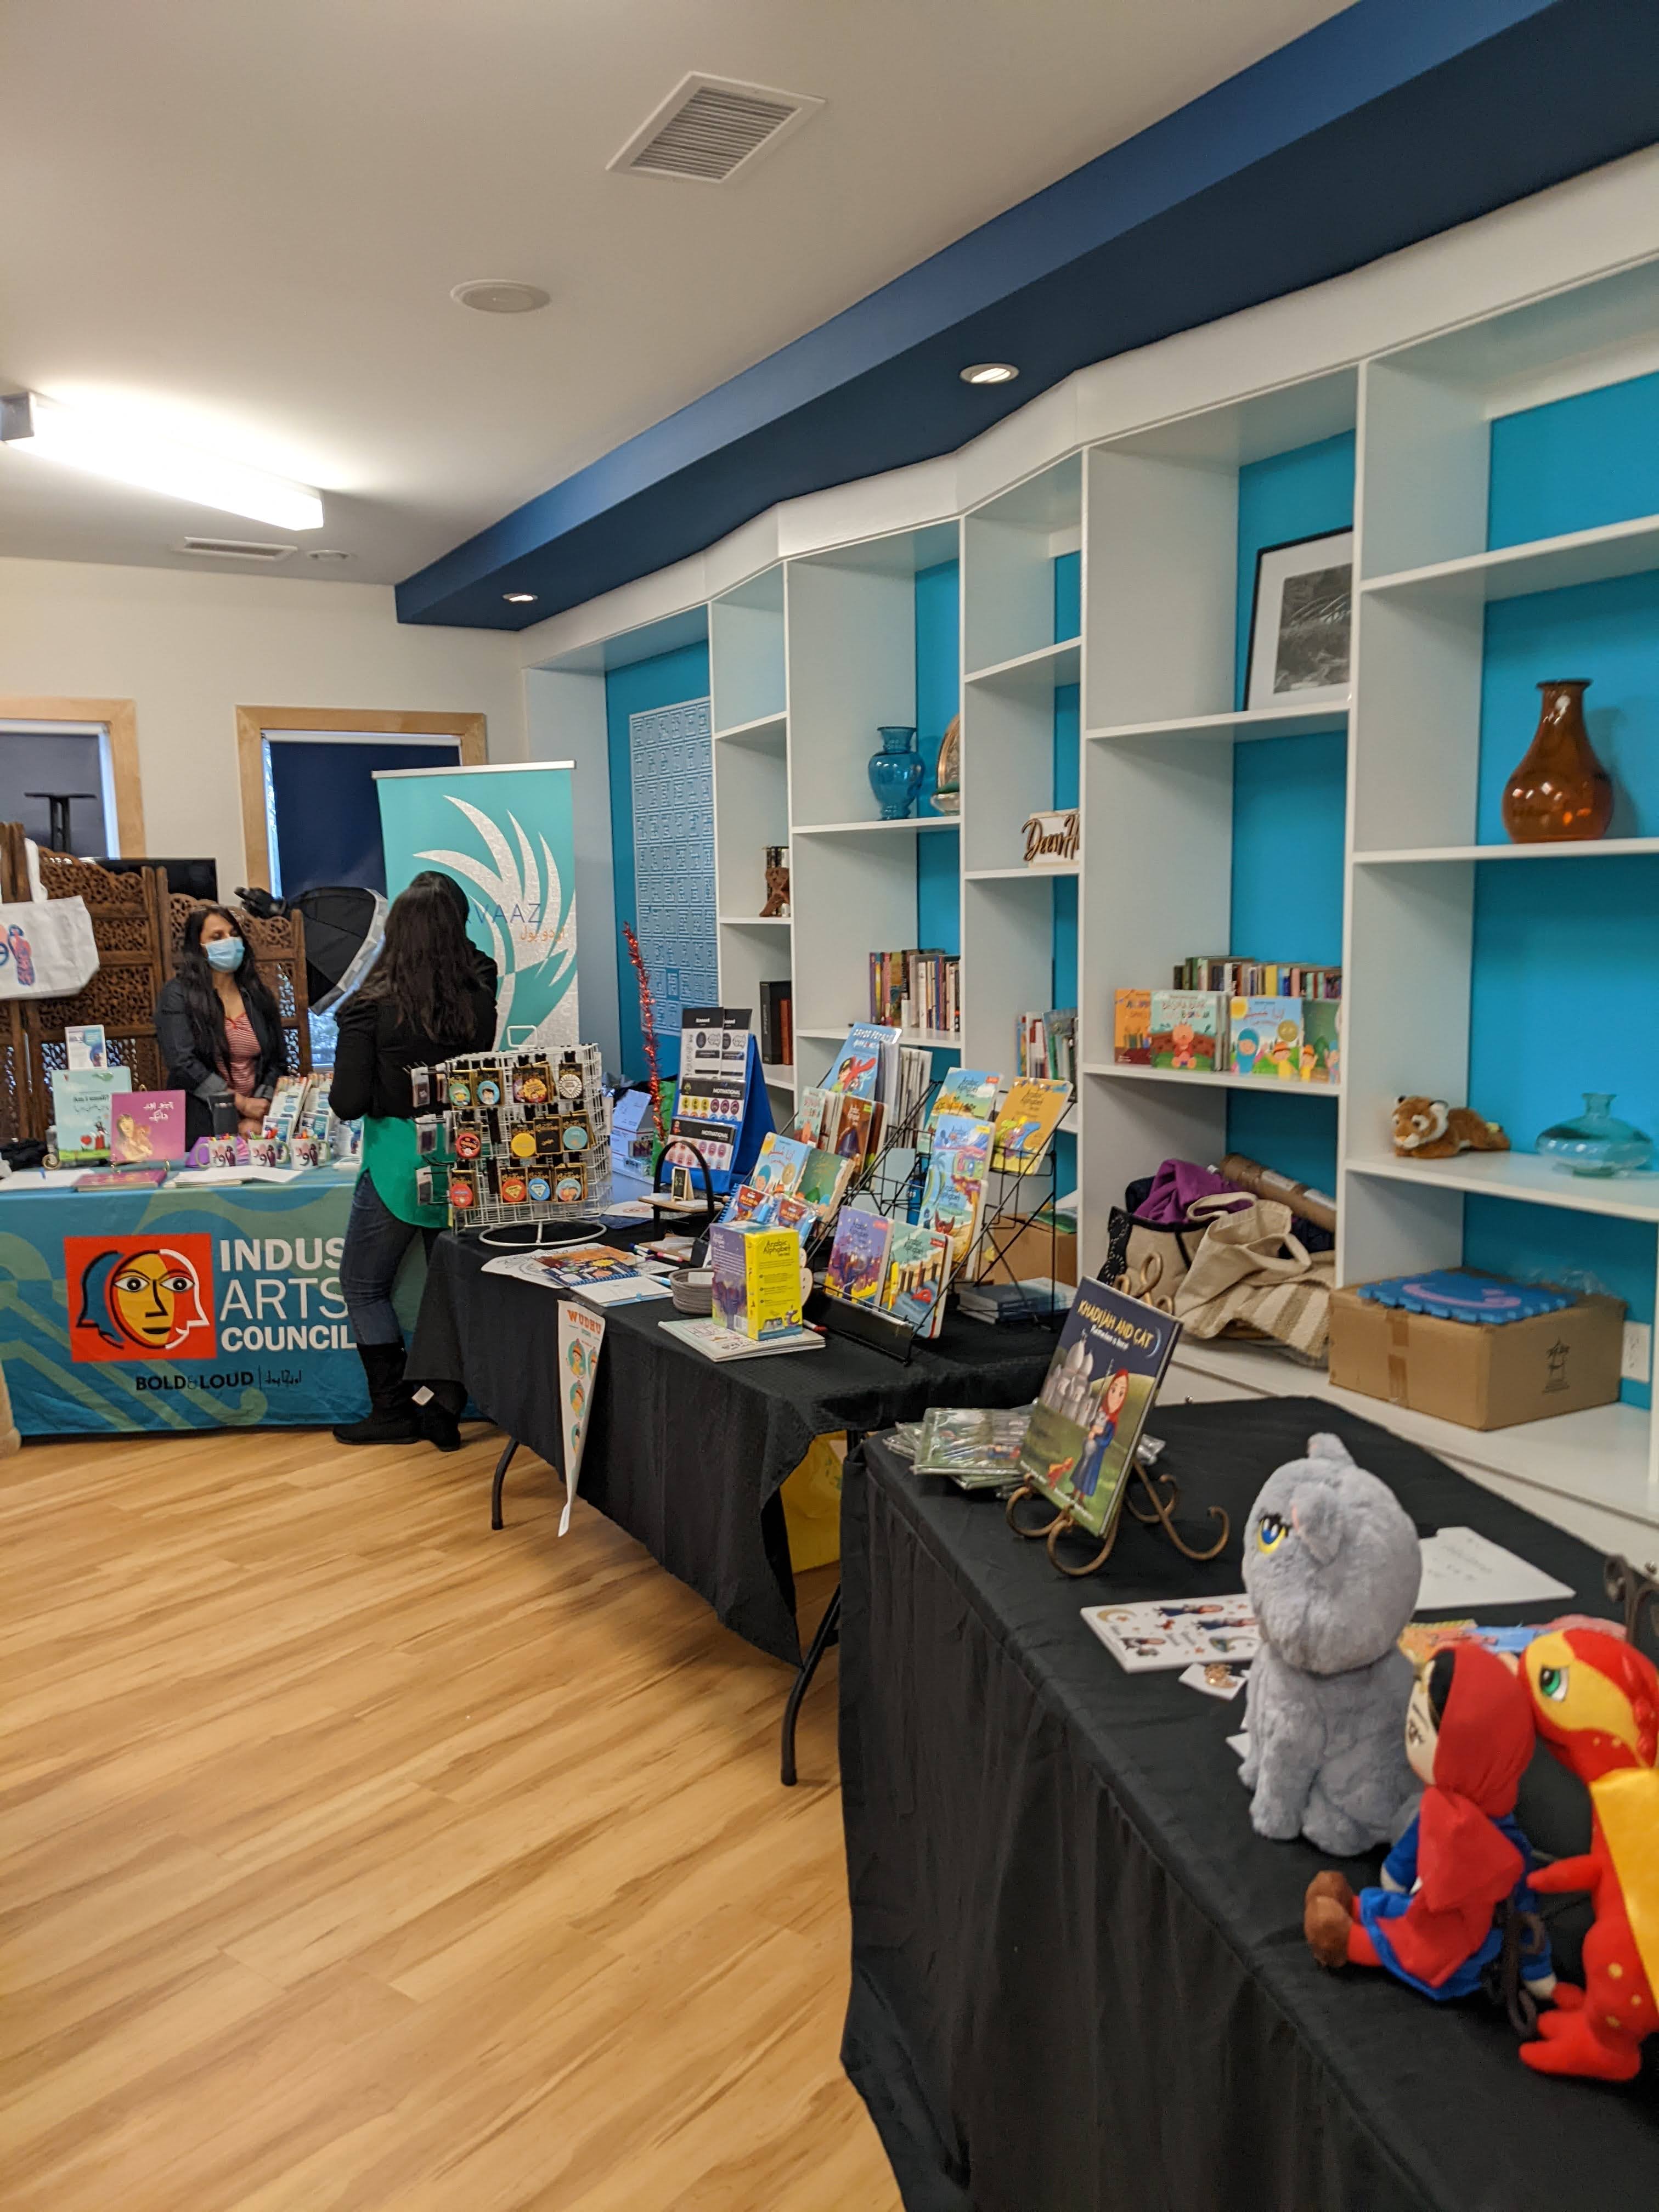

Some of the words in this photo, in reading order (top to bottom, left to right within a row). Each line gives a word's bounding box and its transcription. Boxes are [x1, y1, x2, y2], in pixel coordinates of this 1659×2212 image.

[467, 903, 542, 924] VAAZ
[220, 1237, 346, 1272] INDUS
[763, 1244, 791, 1255] Alphabet
[766, 1239, 787, 1247] Arabic
[220, 1277, 348, 1322] ARTS
[567, 1309, 601, 1335] WUDHU
[1077, 1299, 1116, 1330] KHADIJAH
[1114, 1317, 1135, 1340] AND
[1133, 1327, 1155, 1350] CAT
[221, 1325, 357, 1352] COUNCIL
